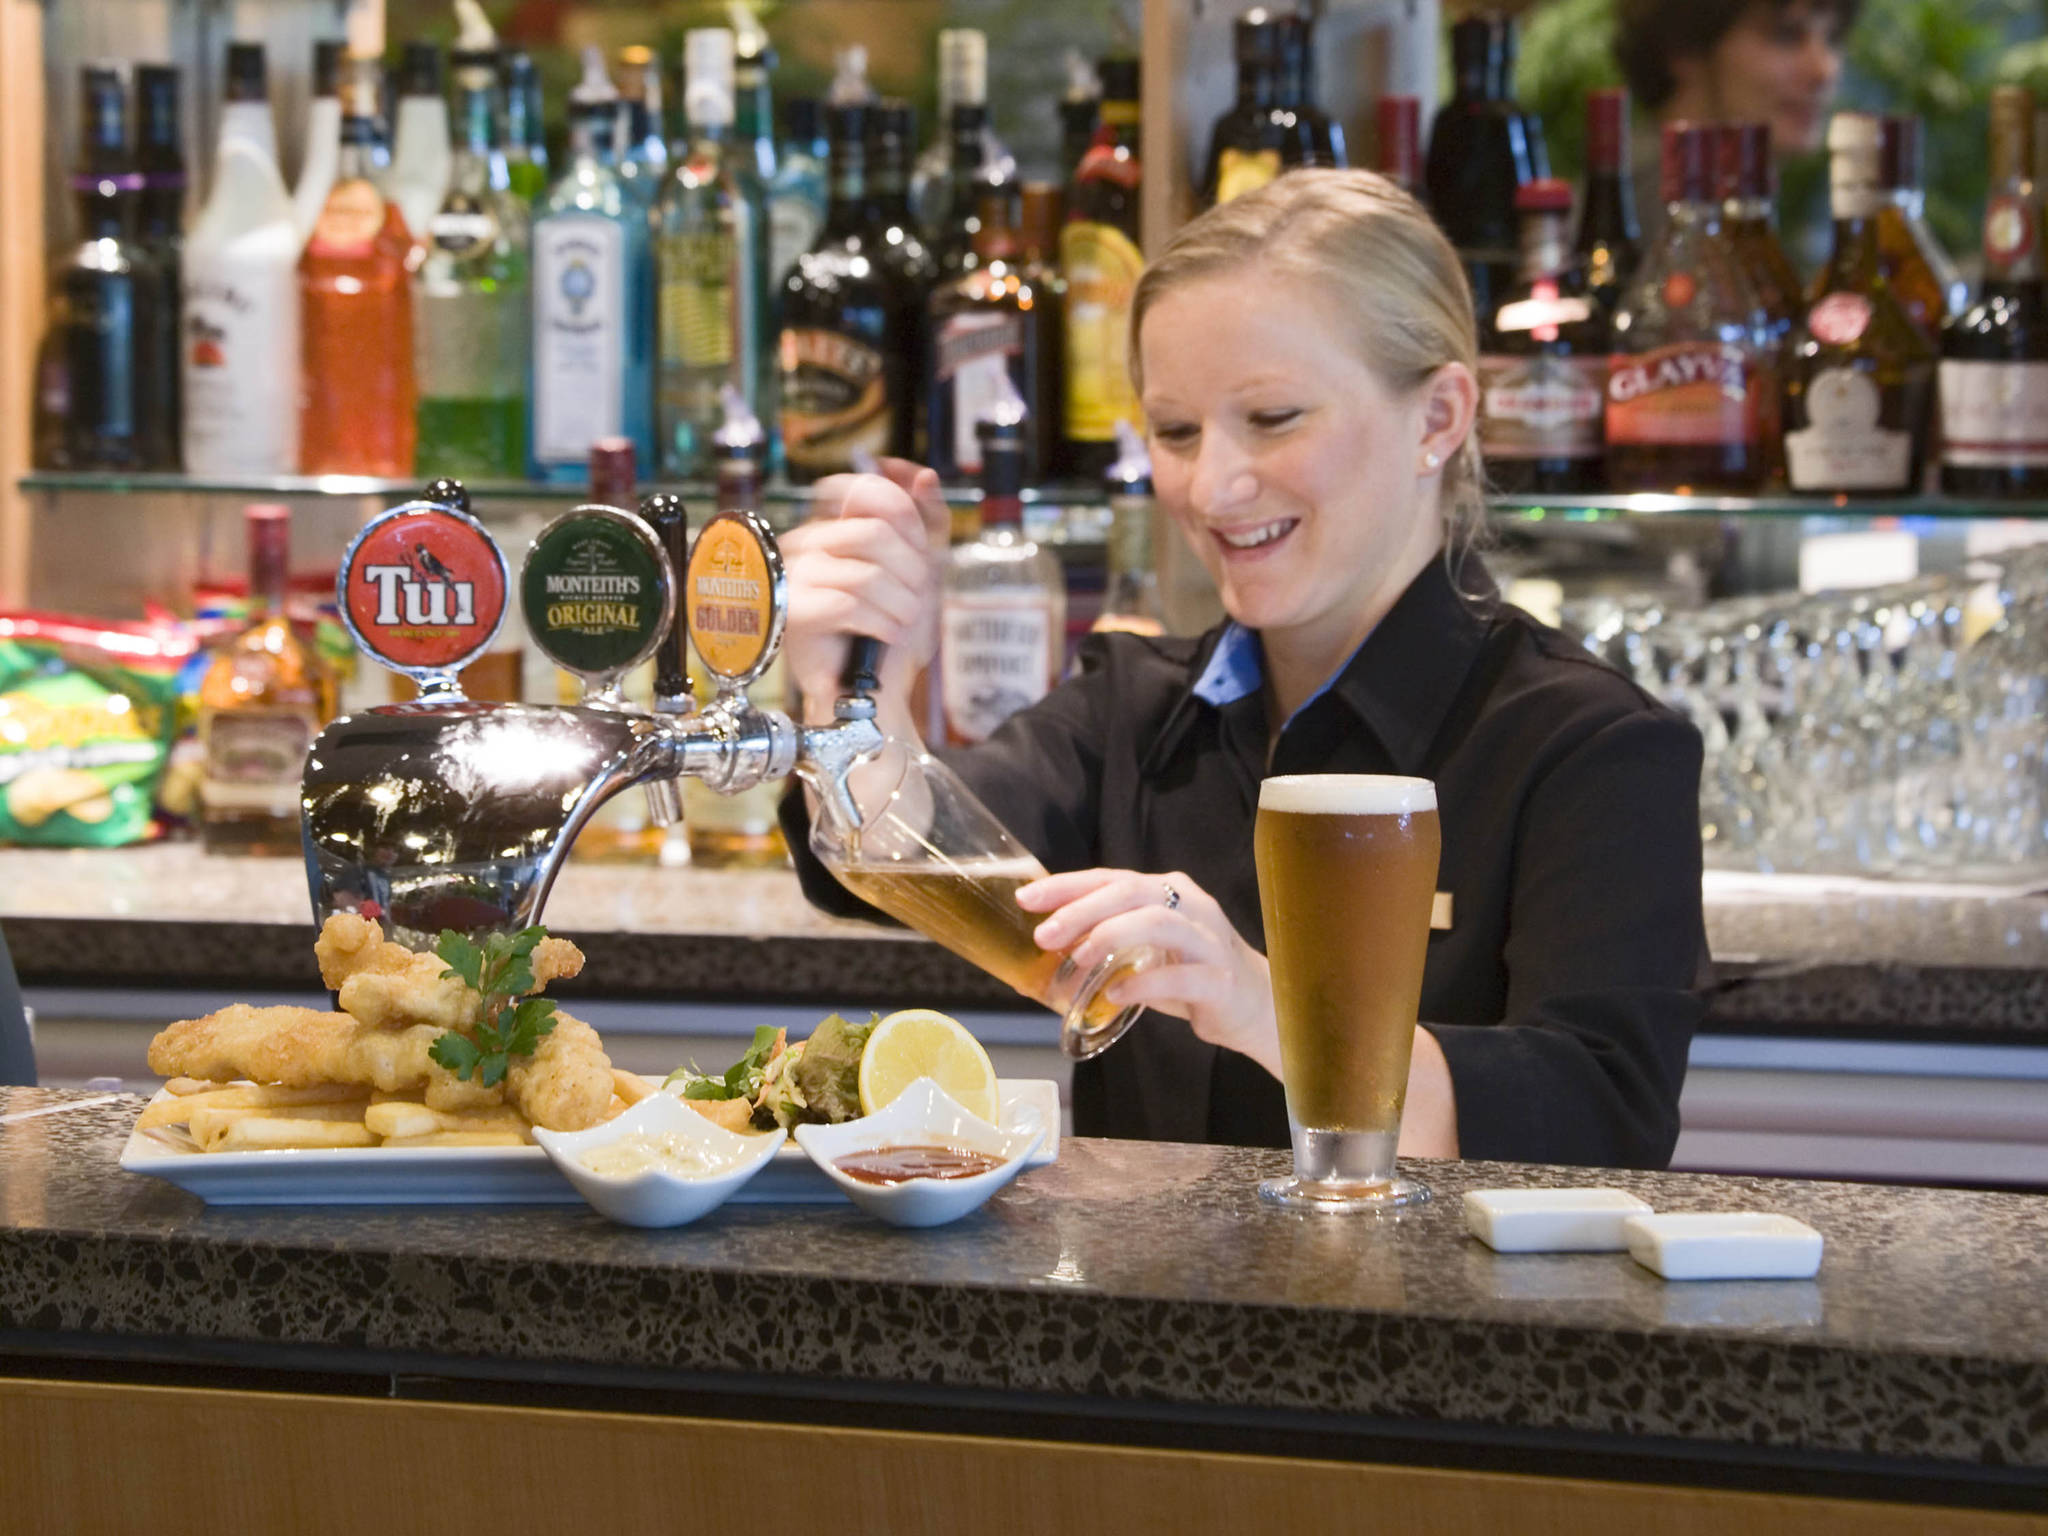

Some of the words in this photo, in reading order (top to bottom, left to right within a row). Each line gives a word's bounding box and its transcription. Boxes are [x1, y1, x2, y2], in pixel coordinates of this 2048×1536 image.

[364, 564, 477, 626] Tui
[546, 575, 641, 594] MONTEITH'S
[547, 603, 640, 627] ORIGINAL
[696, 604, 760, 635] GOLDEN
